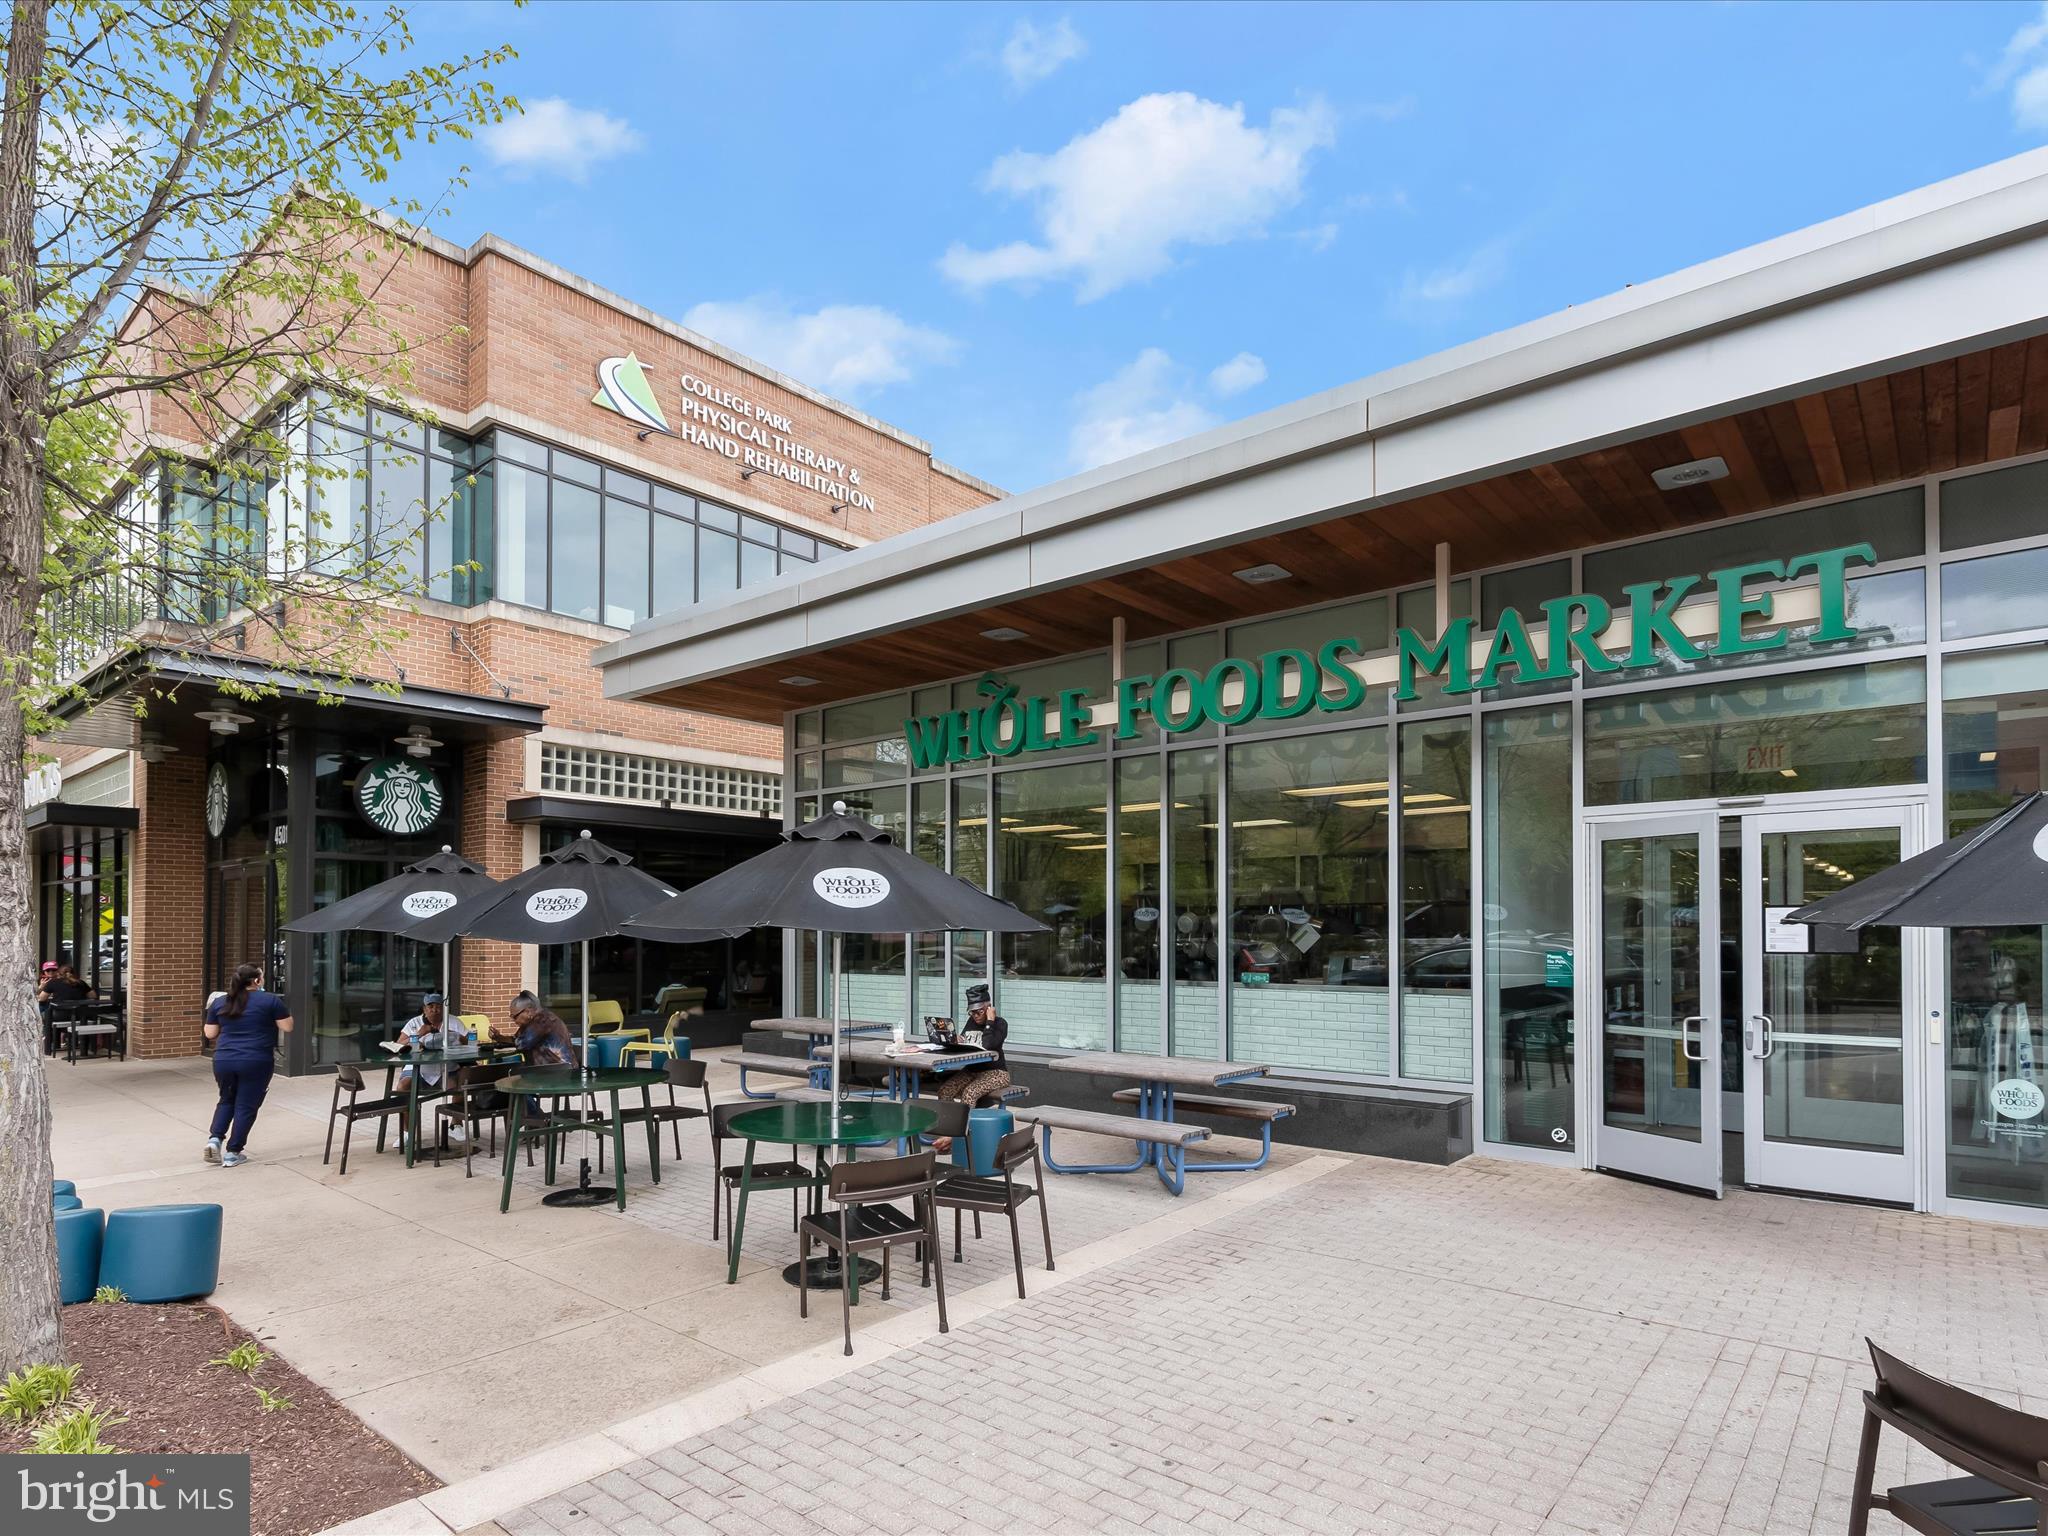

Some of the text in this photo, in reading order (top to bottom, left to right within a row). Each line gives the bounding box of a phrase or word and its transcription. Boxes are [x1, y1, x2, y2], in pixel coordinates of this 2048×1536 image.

[680, 373, 793, 435] COLLEGE PARK
[681, 396, 861, 486] PHYSICAL THERAPY &
[681, 421, 875, 513] HAND REHABILITATION
[903, 541, 1878, 770] WHOLE FOODS MARKET
[1746, 742, 1786, 770] EXIT
[274, 824, 289, 845] 4501
[821, 876, 881, 886] WHOLE
[826, 885, 881, 895] FOODS
[535, 903, 579, 911] FOODS
[536, 896, 582, 904] WHOLE
[1997, 1088, 2039, 1099] WHOLE
[1999, 1098, 2038, 1108] FOODS
